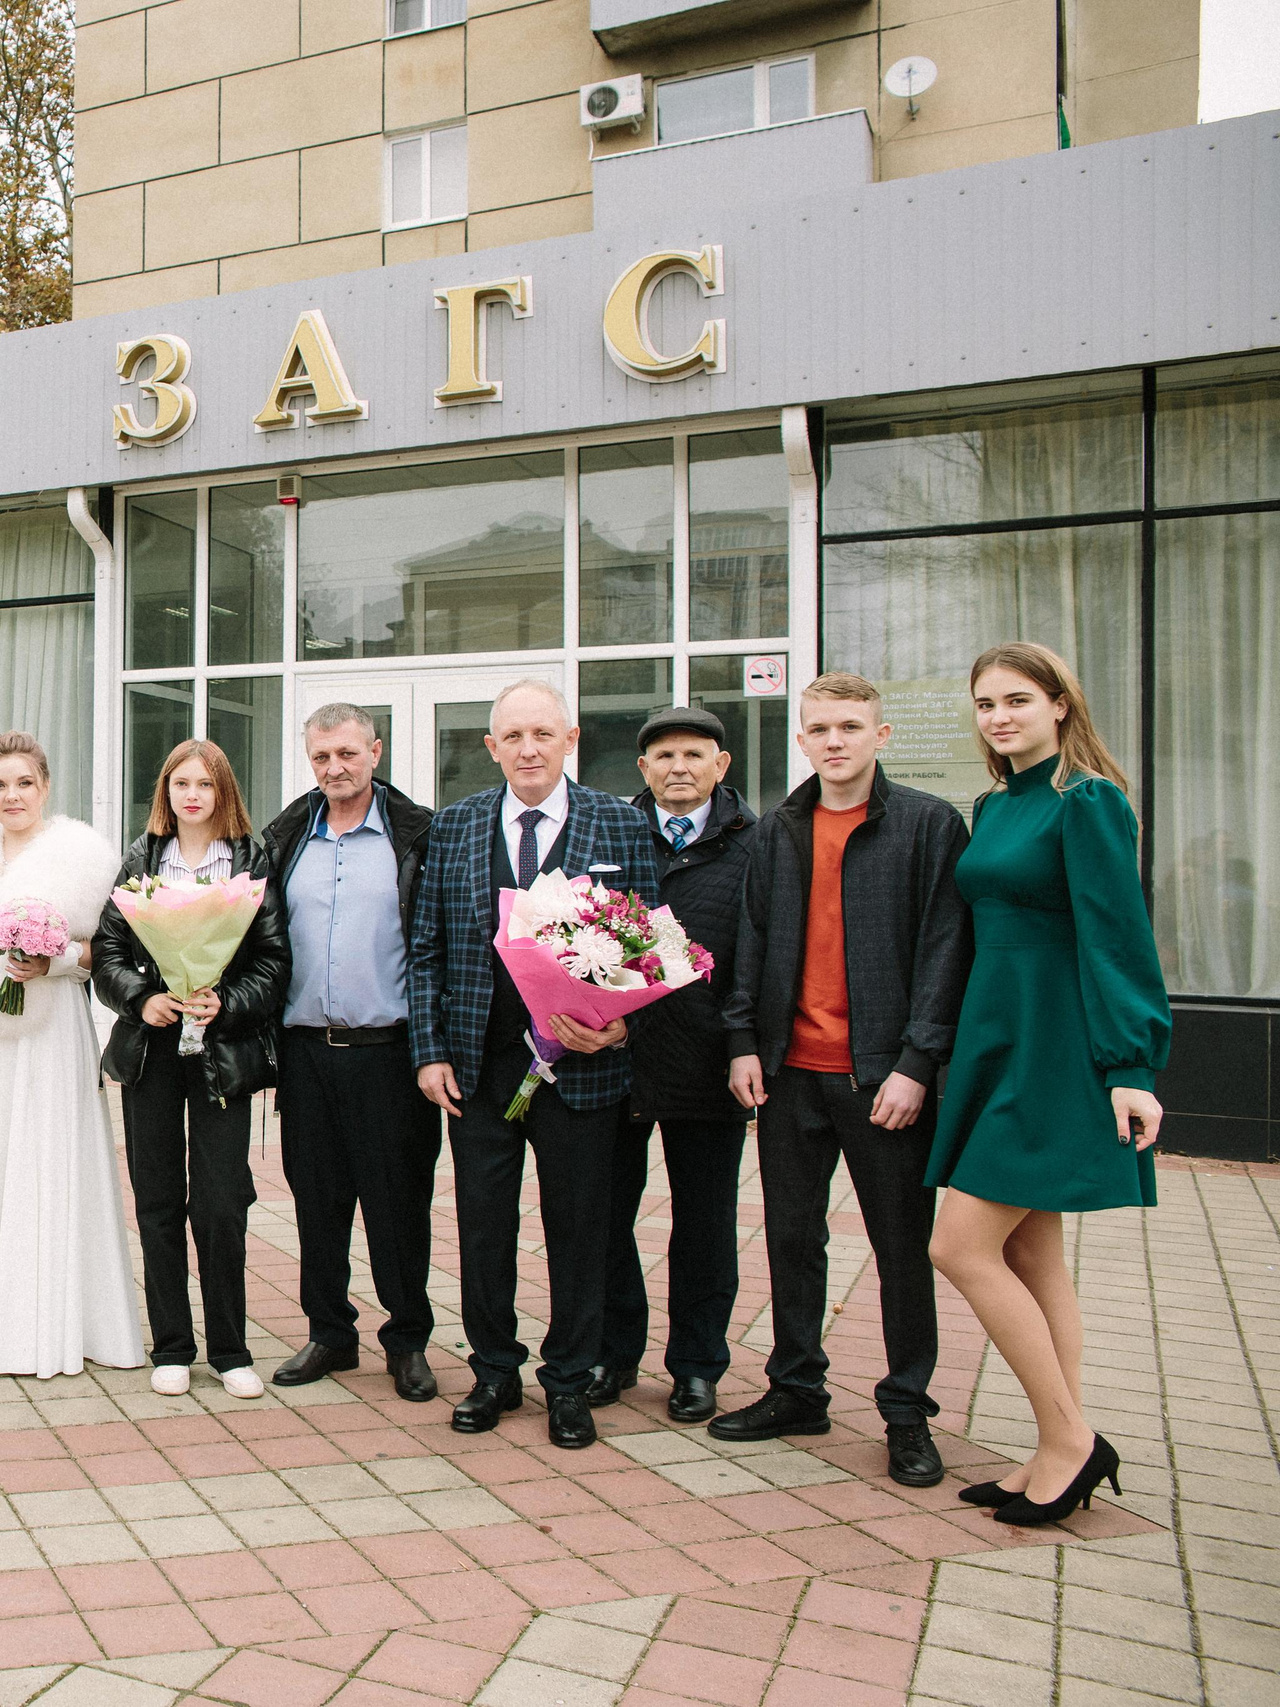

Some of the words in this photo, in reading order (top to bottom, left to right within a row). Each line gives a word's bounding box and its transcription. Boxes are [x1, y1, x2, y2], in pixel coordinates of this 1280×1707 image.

[113, 245, 726, 448] ЗАГС
[889, 692, 913, 700] ЗАГС
[883, 702, 928, 711] равления
[930, 700, 954, 708] ЗАГС
[883, 712, 921, 720] публики
